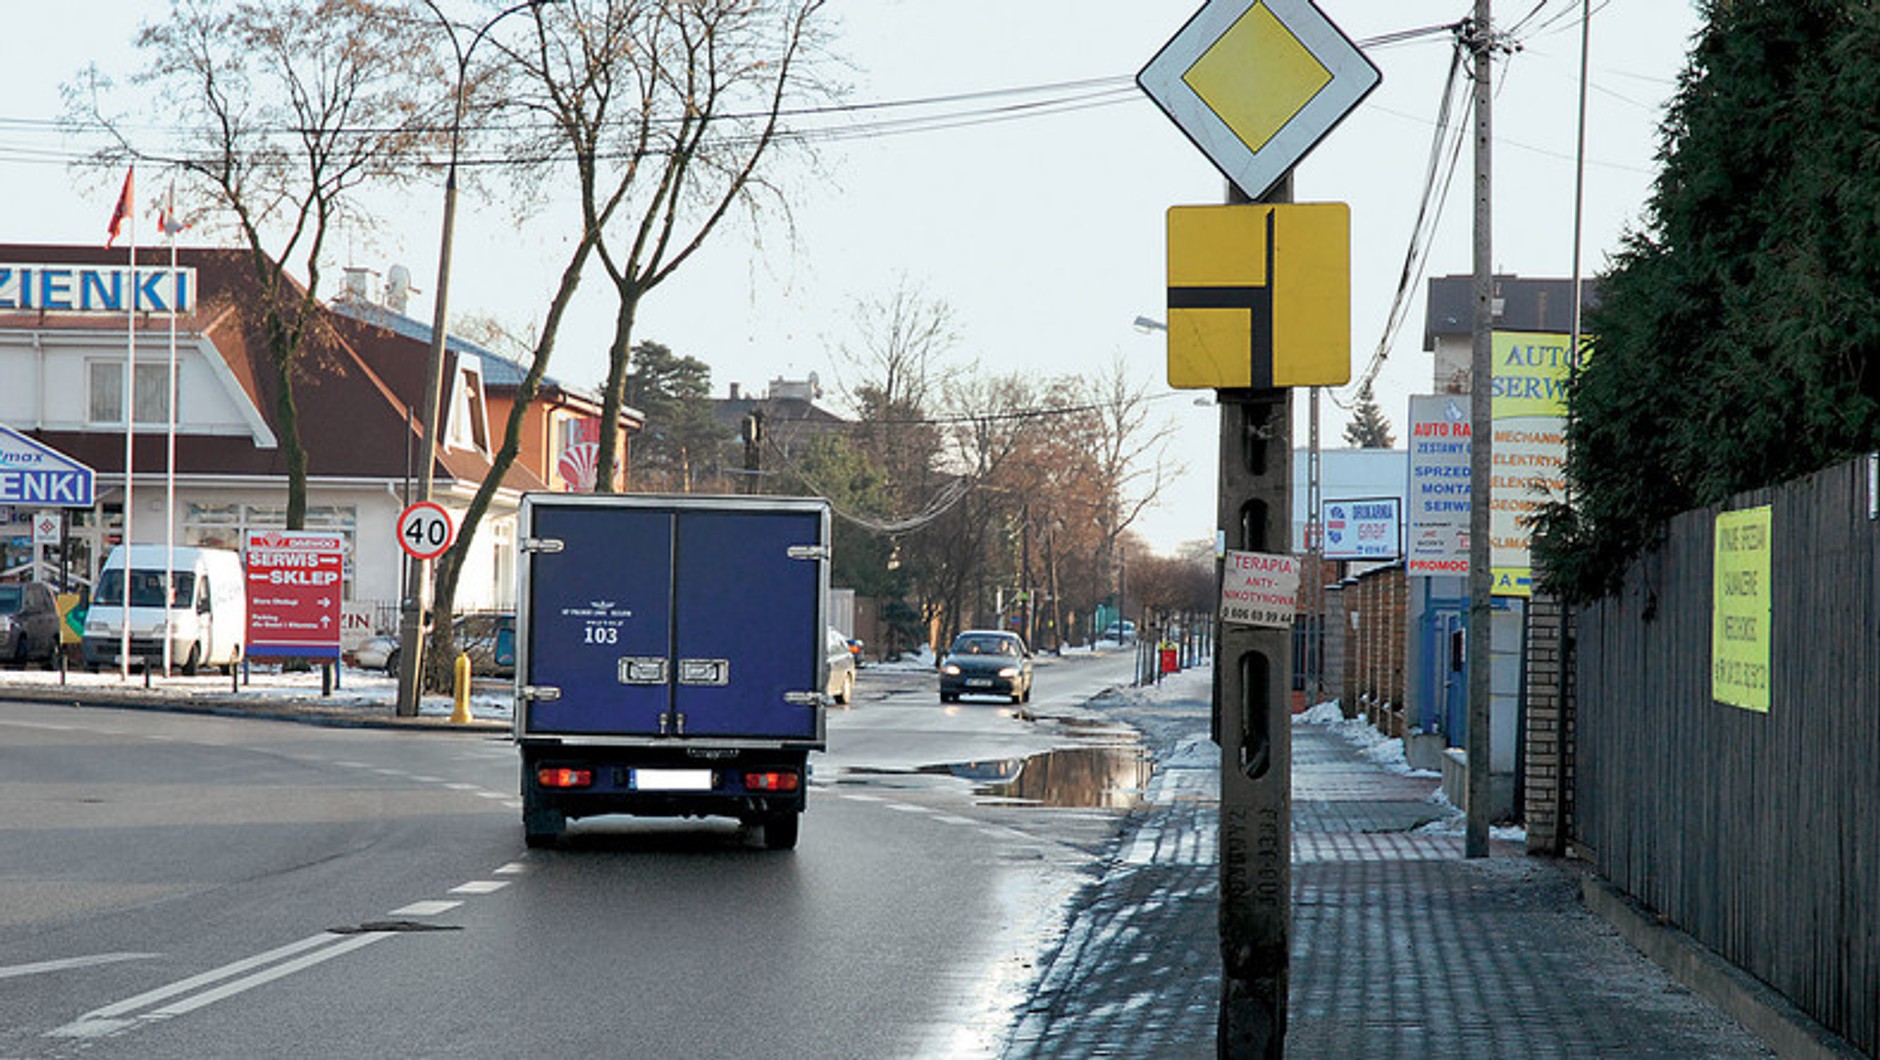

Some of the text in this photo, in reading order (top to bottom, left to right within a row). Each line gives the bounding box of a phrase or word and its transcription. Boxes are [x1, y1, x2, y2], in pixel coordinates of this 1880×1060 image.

[1413, 422, 1449, 437] AUTO
[1415, 466, 1472, 478] SPRZED
[406, 517, 445, 546] 40
[250, 552, 319, 567] SERWIS
[1235, 555, 1292, 574] TERAPIA
[1409, 560, 1469, 572] PROMOC
[270, 570, 338, 585] SKLEP
[1245, 576, 1279, 588] ANTY-
[1224, 589, 1294, 605] NIKOTYNOWA
[584, 627, 618, 644] 103
